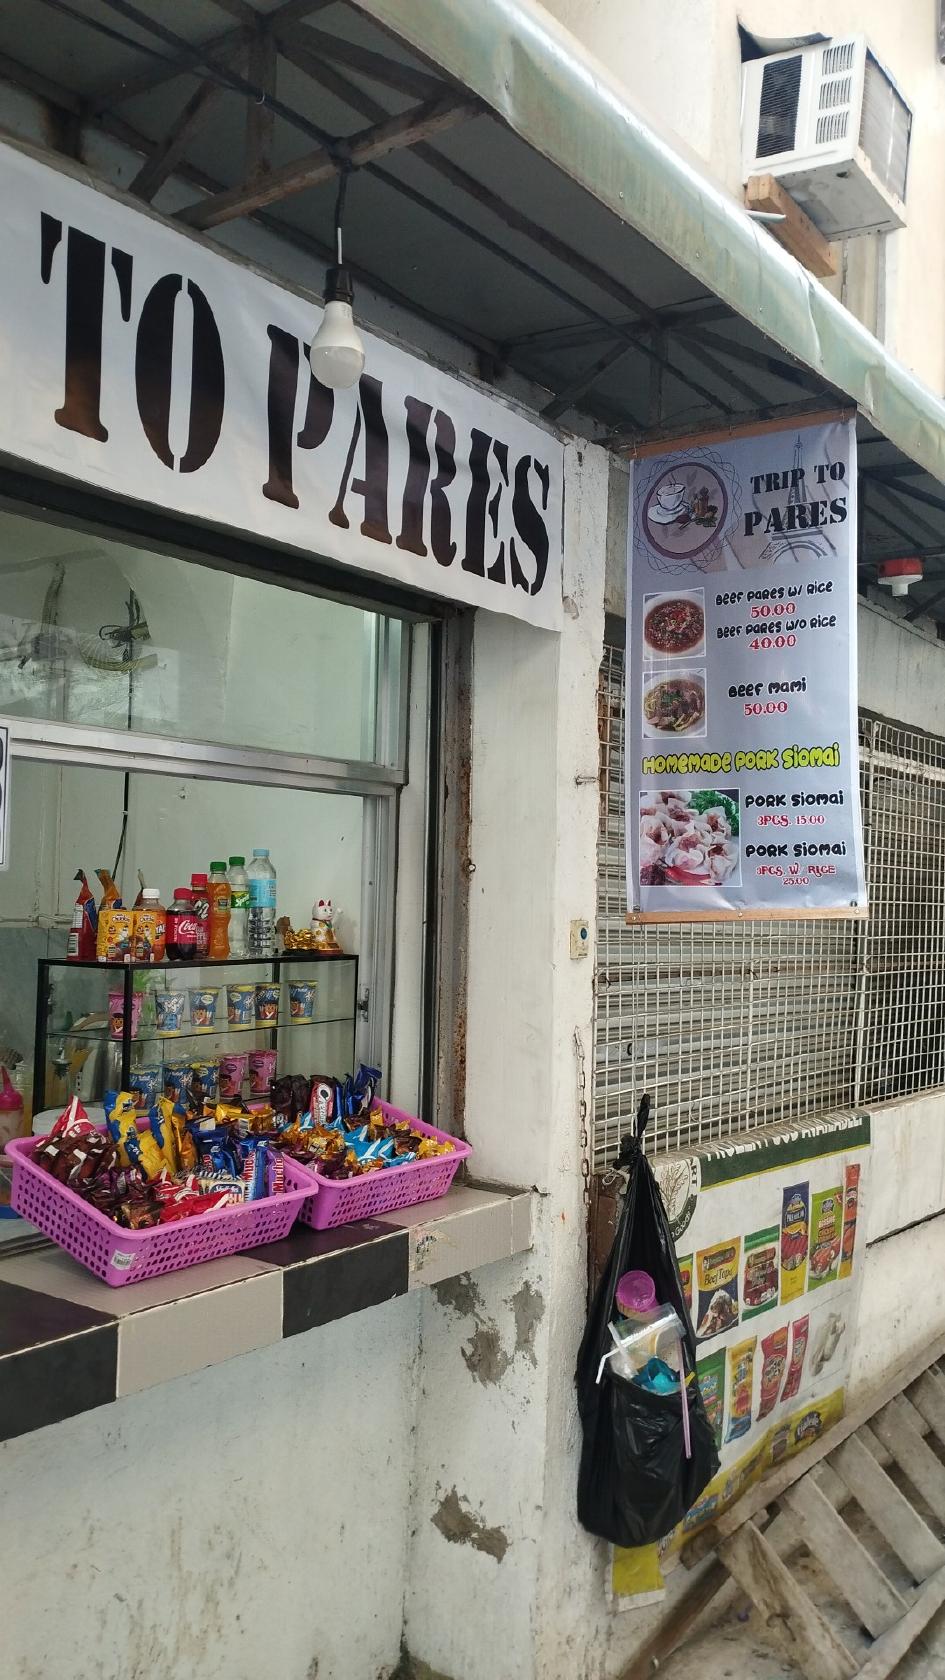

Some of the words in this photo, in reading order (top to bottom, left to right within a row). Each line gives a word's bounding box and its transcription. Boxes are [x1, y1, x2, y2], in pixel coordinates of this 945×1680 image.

[40, 211, 225, 474] TO
[262, 323, 550, 596] PARES
[750, 468, 805, 495] TRIP
[813, 461, 846, 484] TO
[743, 497, 848, 537] PARES
[750, 602, 796, 619] 50.00
[749, 634, 796, 651] 40.00
[743, 701, 788, 716] 50.00
